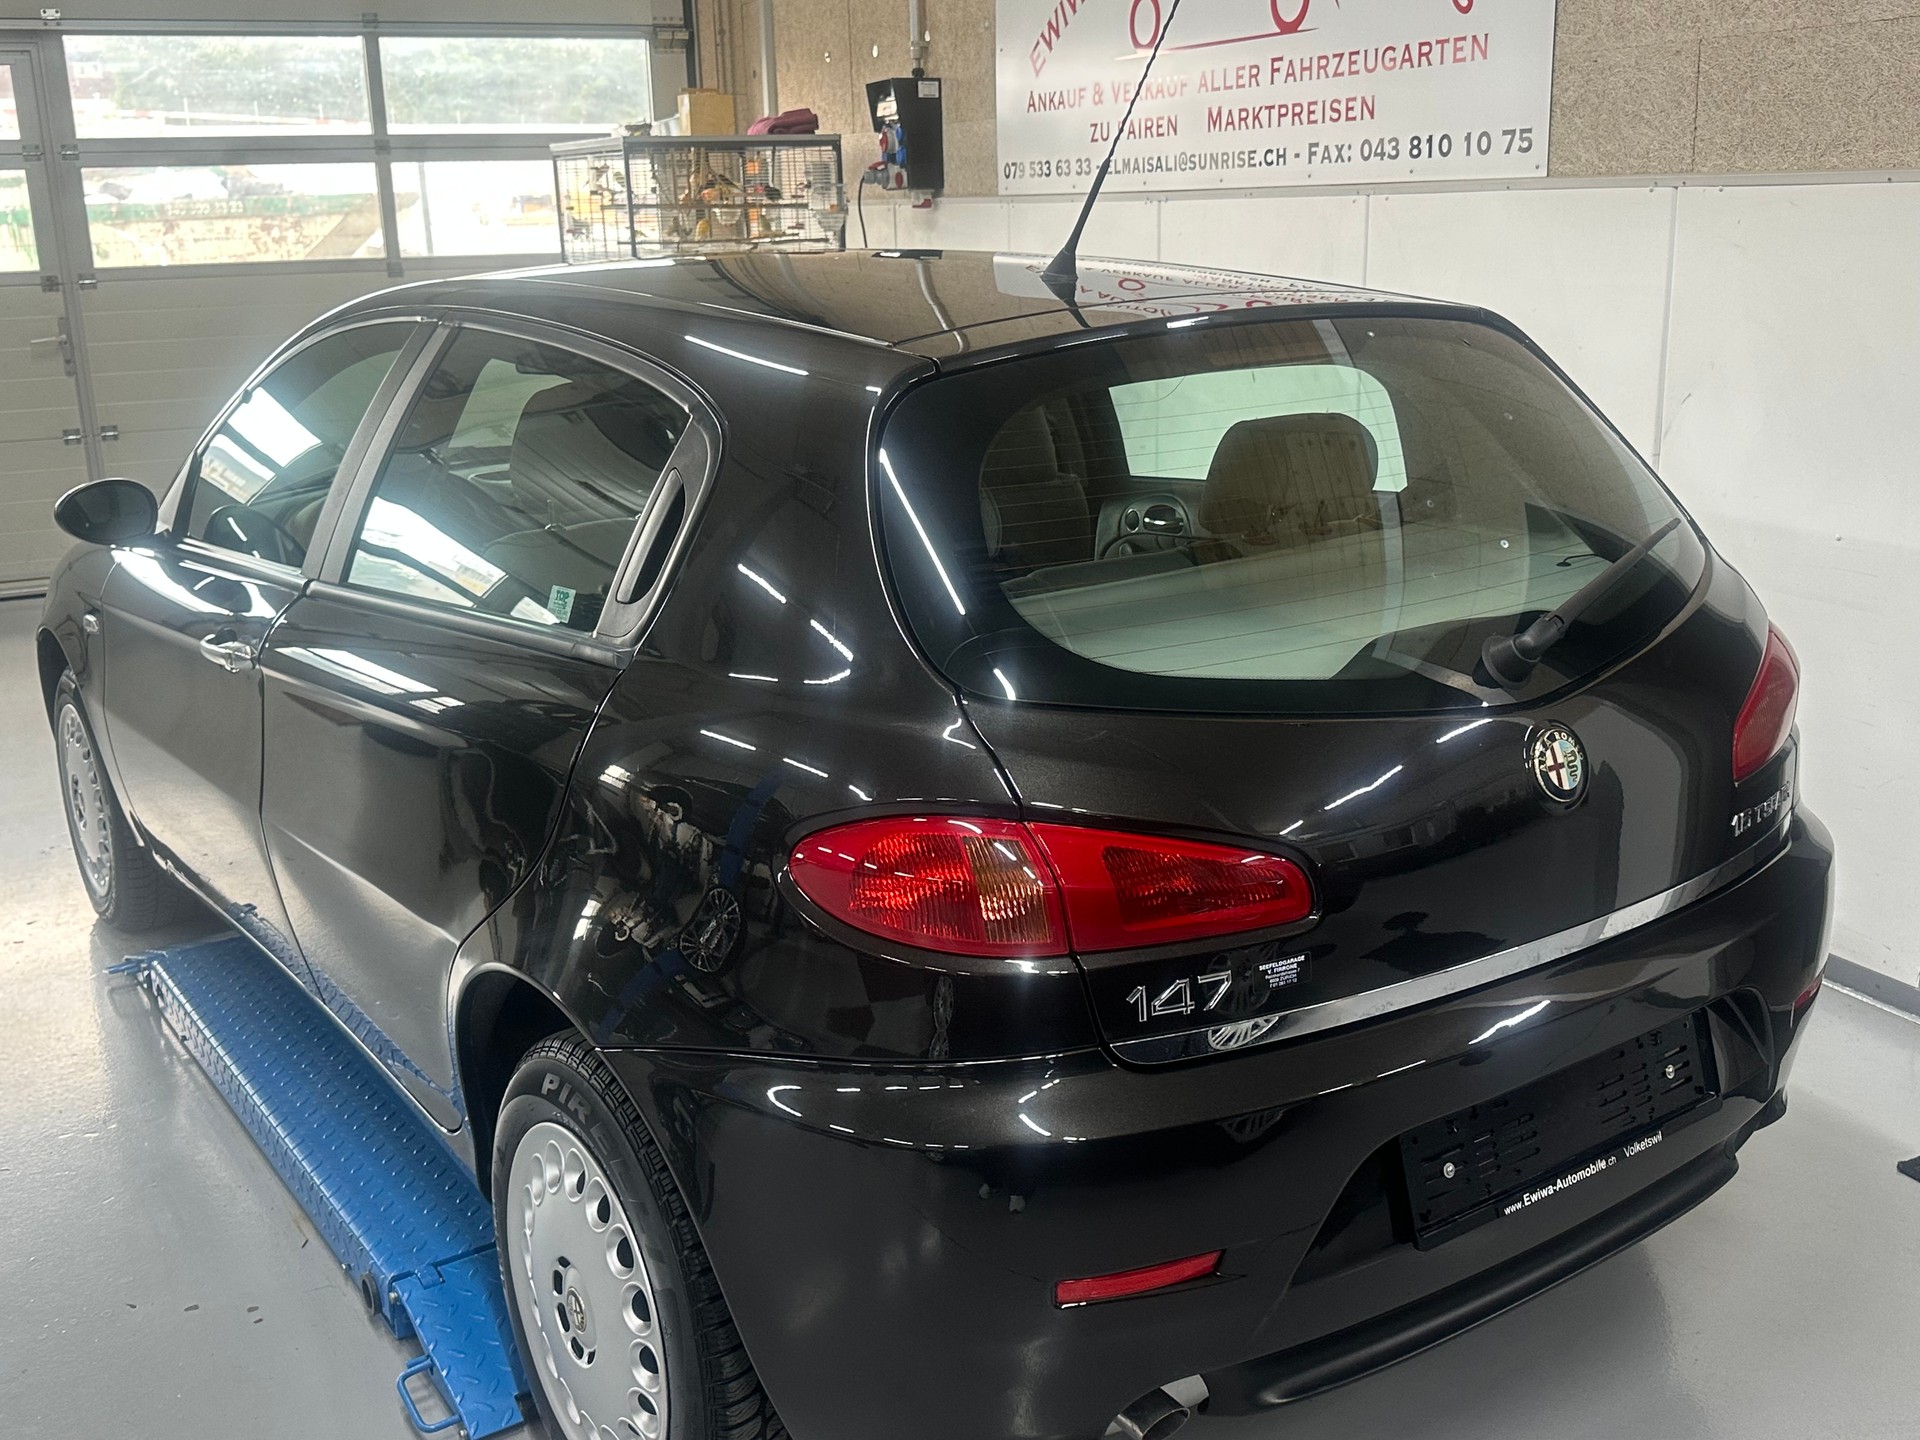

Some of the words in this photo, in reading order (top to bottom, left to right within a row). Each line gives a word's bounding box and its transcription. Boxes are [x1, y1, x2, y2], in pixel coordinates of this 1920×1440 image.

[1027, 86, 1087, 113] ANKAUF
[1093, 81, 1104, 105] &
[1198, 64, 1260, 93] ALLER
[1270, 33, 1489, 86] FAHRZEUGARTEN
[1090, 121, 1110, 143] ZU
[1207, 95, 1376, 133] MARKTPREISEN
[1004, 162, 1026, 180] 079
[1029, 160, 1052, 179] 533
[1055, 158, 1071, 177] 63
[1075, 157, 1092, 176] 33
[1307, 142, 1352, 166] FAX:
[1360, 137, 1400, 162] 043
[1408, 133, 1452, 160] 810
[1464, 131, 1492, 157] 10
[1501, 127, 1533, 154] 75
[1126, 970, 1232, 1023] 147
[1503, 1155, 1617, 1216] www.Ewiwa-Automobile.ch
[1622, 1130, 1664, 1158] Volketswil
